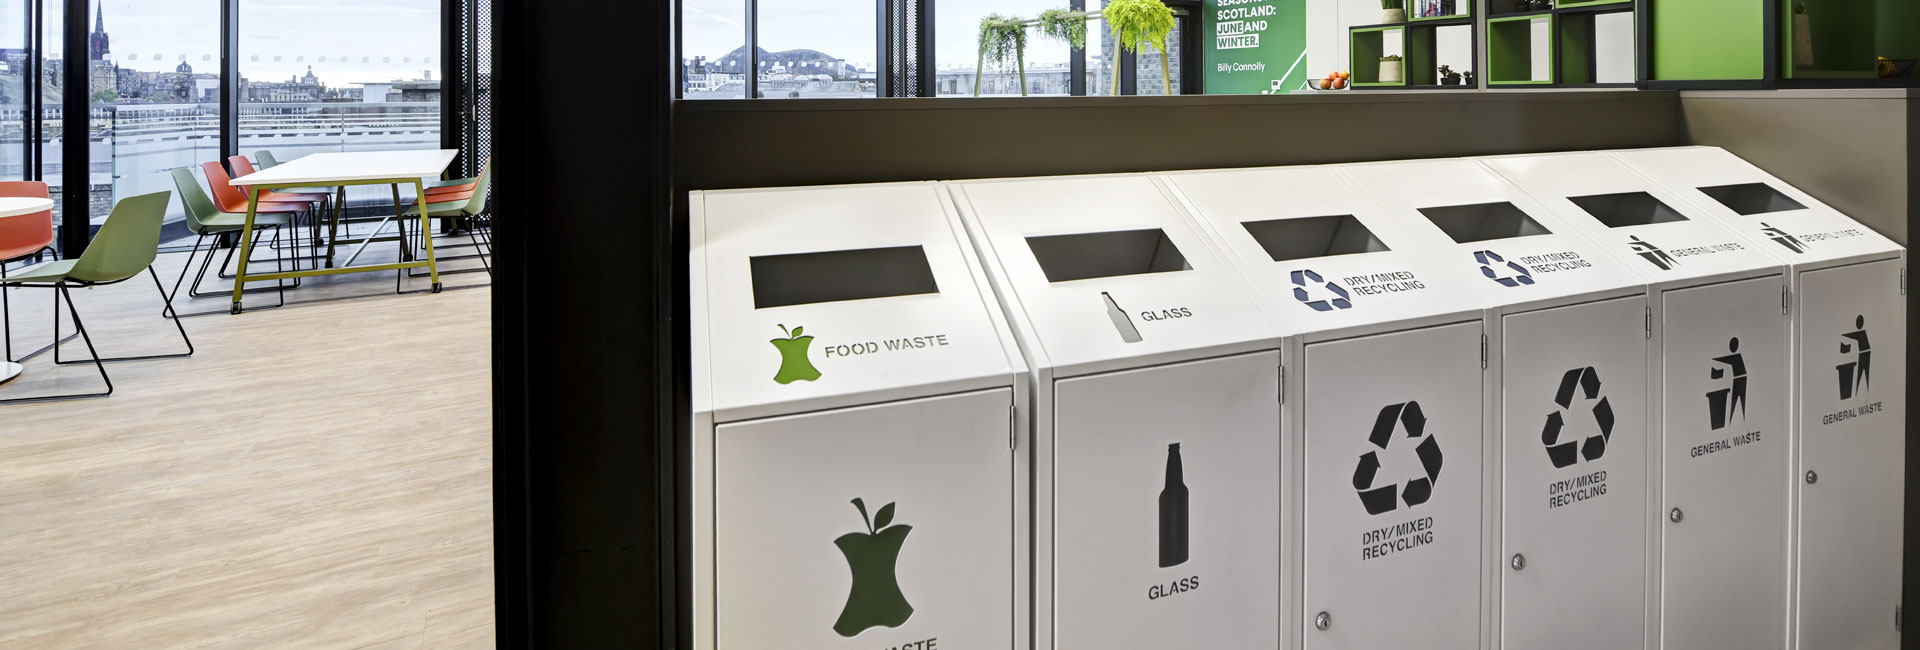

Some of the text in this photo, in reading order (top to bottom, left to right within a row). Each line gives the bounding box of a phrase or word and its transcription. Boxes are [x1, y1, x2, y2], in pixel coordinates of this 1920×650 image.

[1217, 5, 1276, 20] SCOTLAND:
[1217, 20, 1268, 34] JUNE AND
[1217, 35, 1259, 48] WINTER.
[1217, 62, 1265, 73] Billy Connolly
[1670, 242, 1745, 257] GENERAL WASTE
[1520, 251, 1580, 265] DRY/MIXED
[1531, 259, 1592, 274] RECYCLING
[1343, 271, 1415, 286] DRY/MIXED
[1353, 280, 1426, 296] RECYCLING
[1141, 307, 1192, 322] GLASS
[825, 334, 949, 358] FOOD WASTE
[1823, 402, 1882, 425] GENERAL WASTE
[1690, 431, 1761, 458] GENERAL WASTE
[1549, 470, 1607, 495] DRY/MIXED
[1549, 483, 1607, 509] RECYCLING
[1362, 516, 1433, 546] DRY/MIXED
[1362, 531, 1434, 561] RECYCLING
[1148, 575, 1200, 600] GLASS
[884, 637, 938, 650] STE
